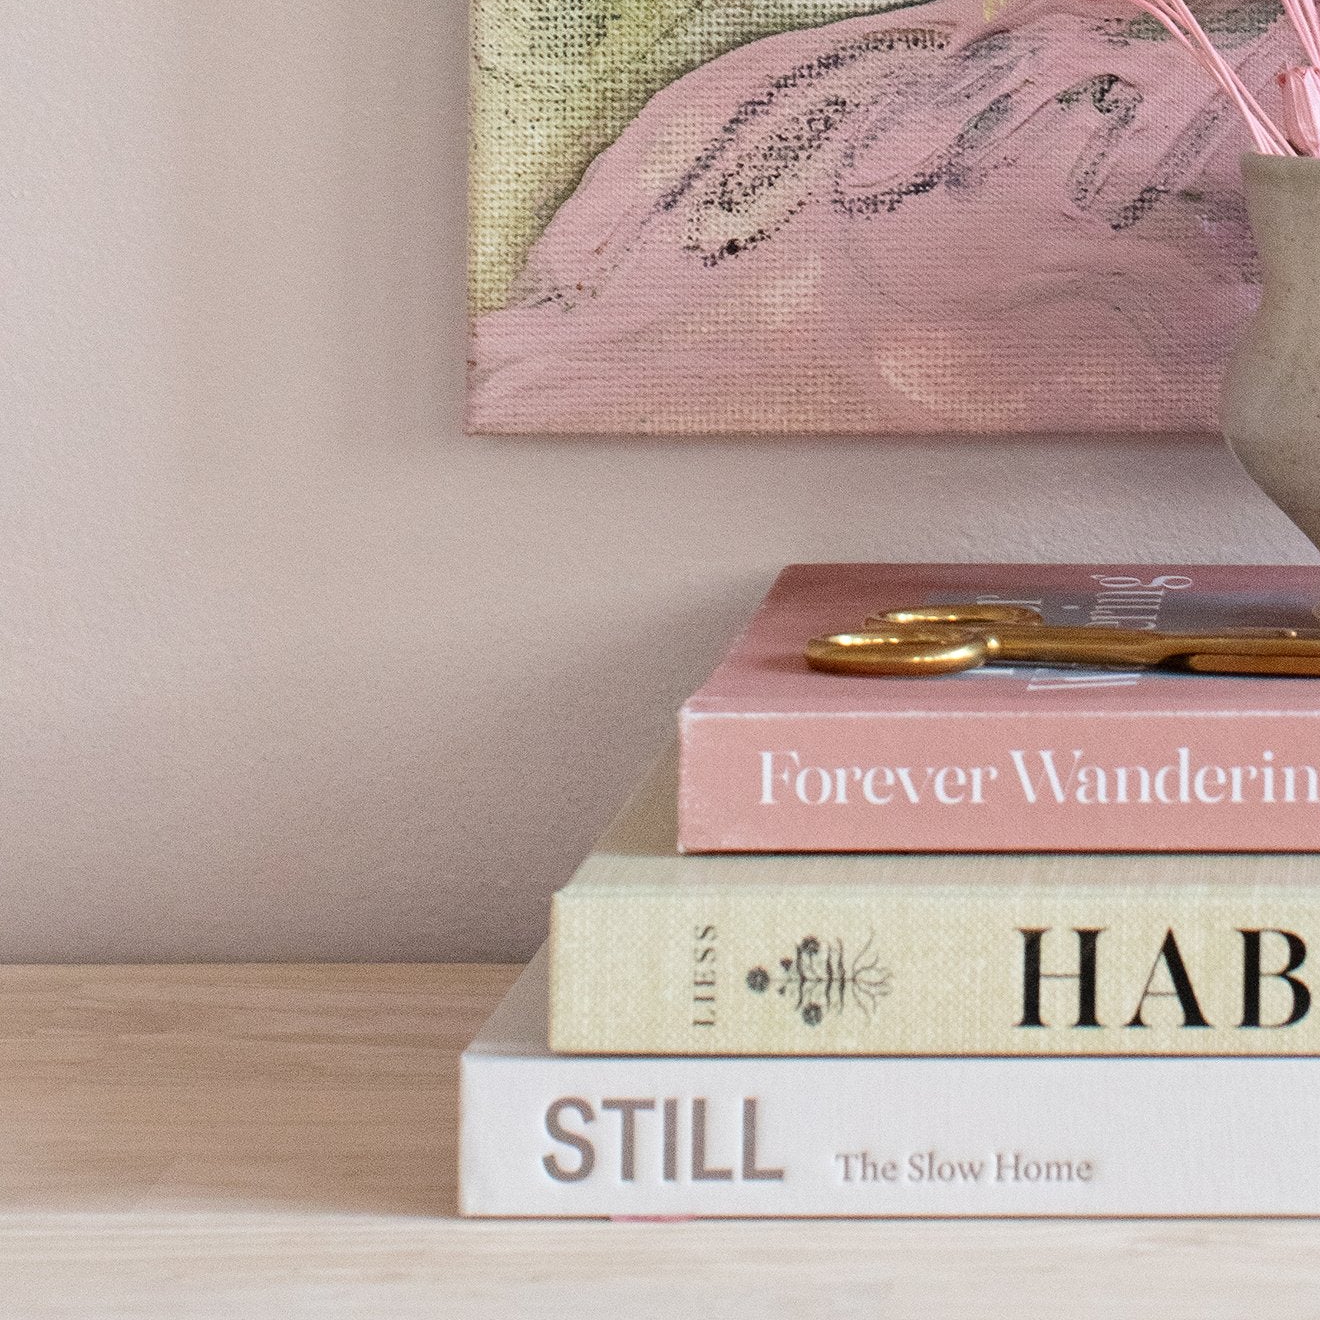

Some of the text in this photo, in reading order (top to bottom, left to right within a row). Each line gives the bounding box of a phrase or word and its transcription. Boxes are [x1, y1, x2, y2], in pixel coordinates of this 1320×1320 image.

[758, 748, 999, 806] Forever
[691, 924, 718, 1028] LIESS
[541, 1096, 786, 1185] STILL
[835, 1149, 1095, 1184] The Slow Home
